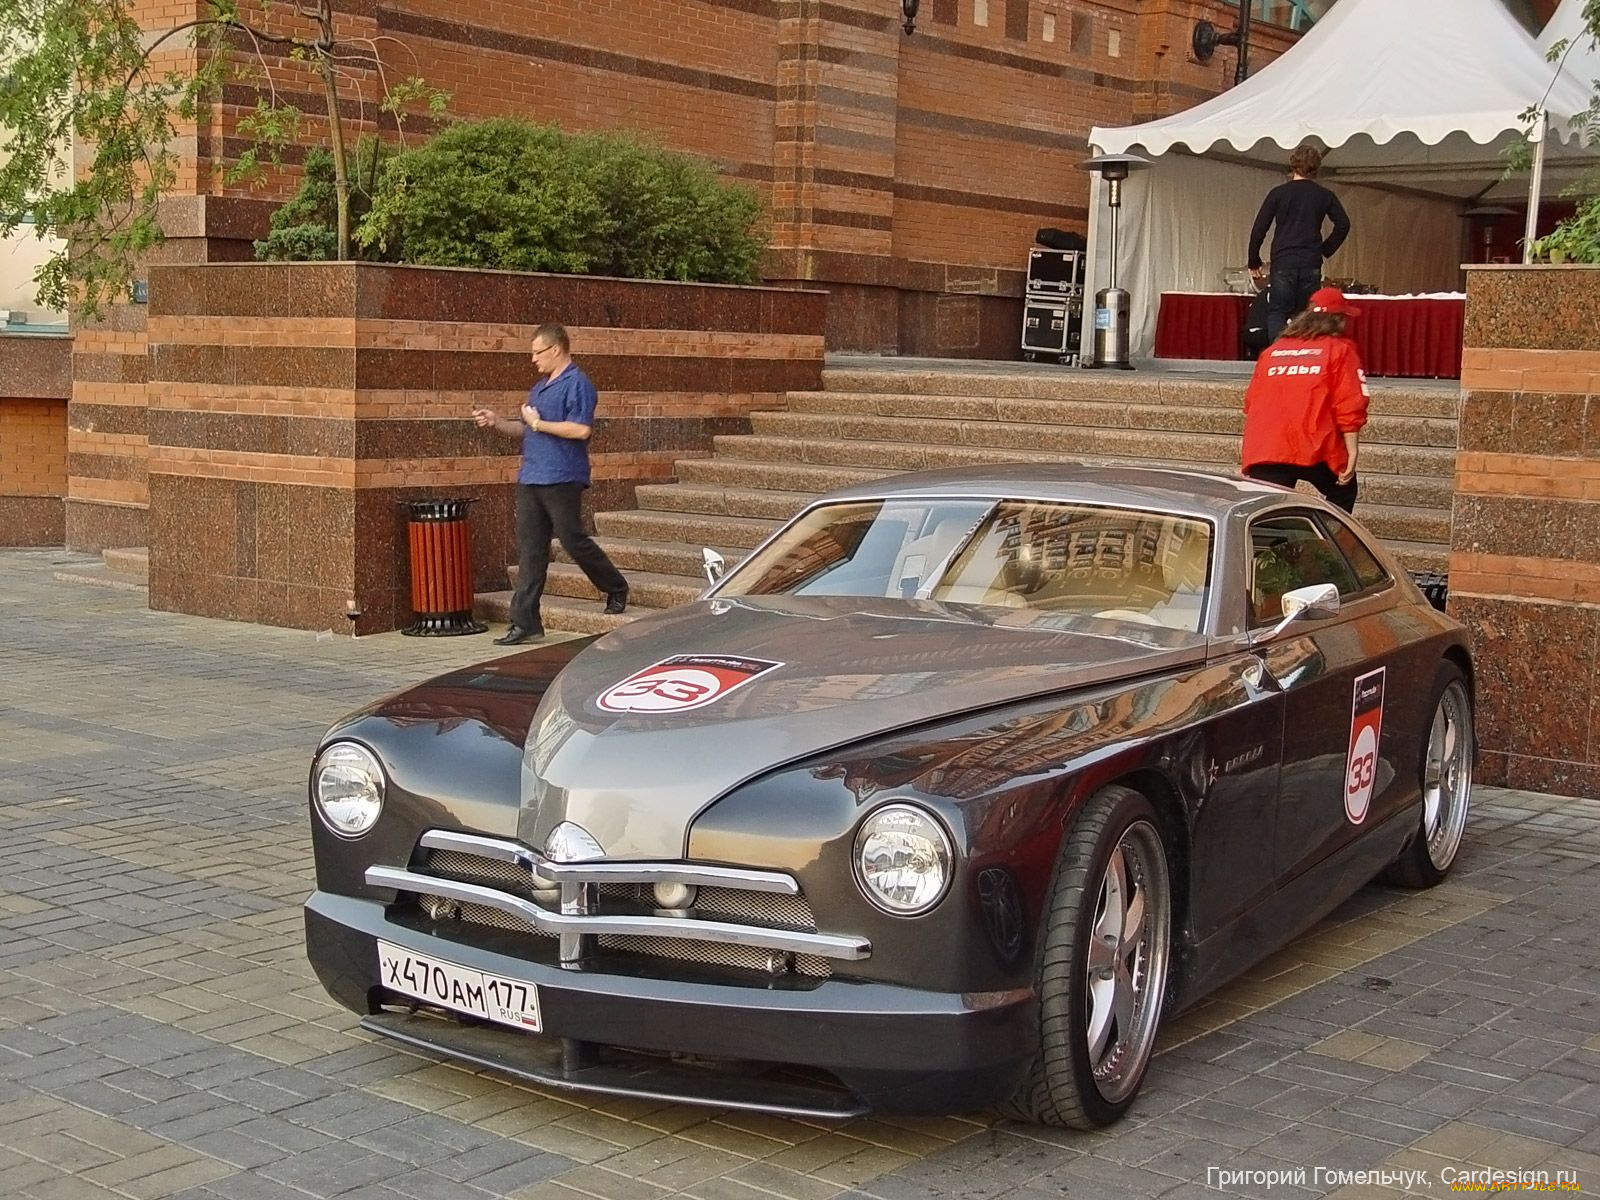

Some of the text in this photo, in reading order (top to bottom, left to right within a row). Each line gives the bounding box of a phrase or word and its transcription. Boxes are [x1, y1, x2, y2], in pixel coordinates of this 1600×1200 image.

[613, 679, 709, 702] 33
[1349, 752, 1374, 794] 33
[488, 980, 526, 1011] 177
[500, 1008, 521, 1021] RUS
